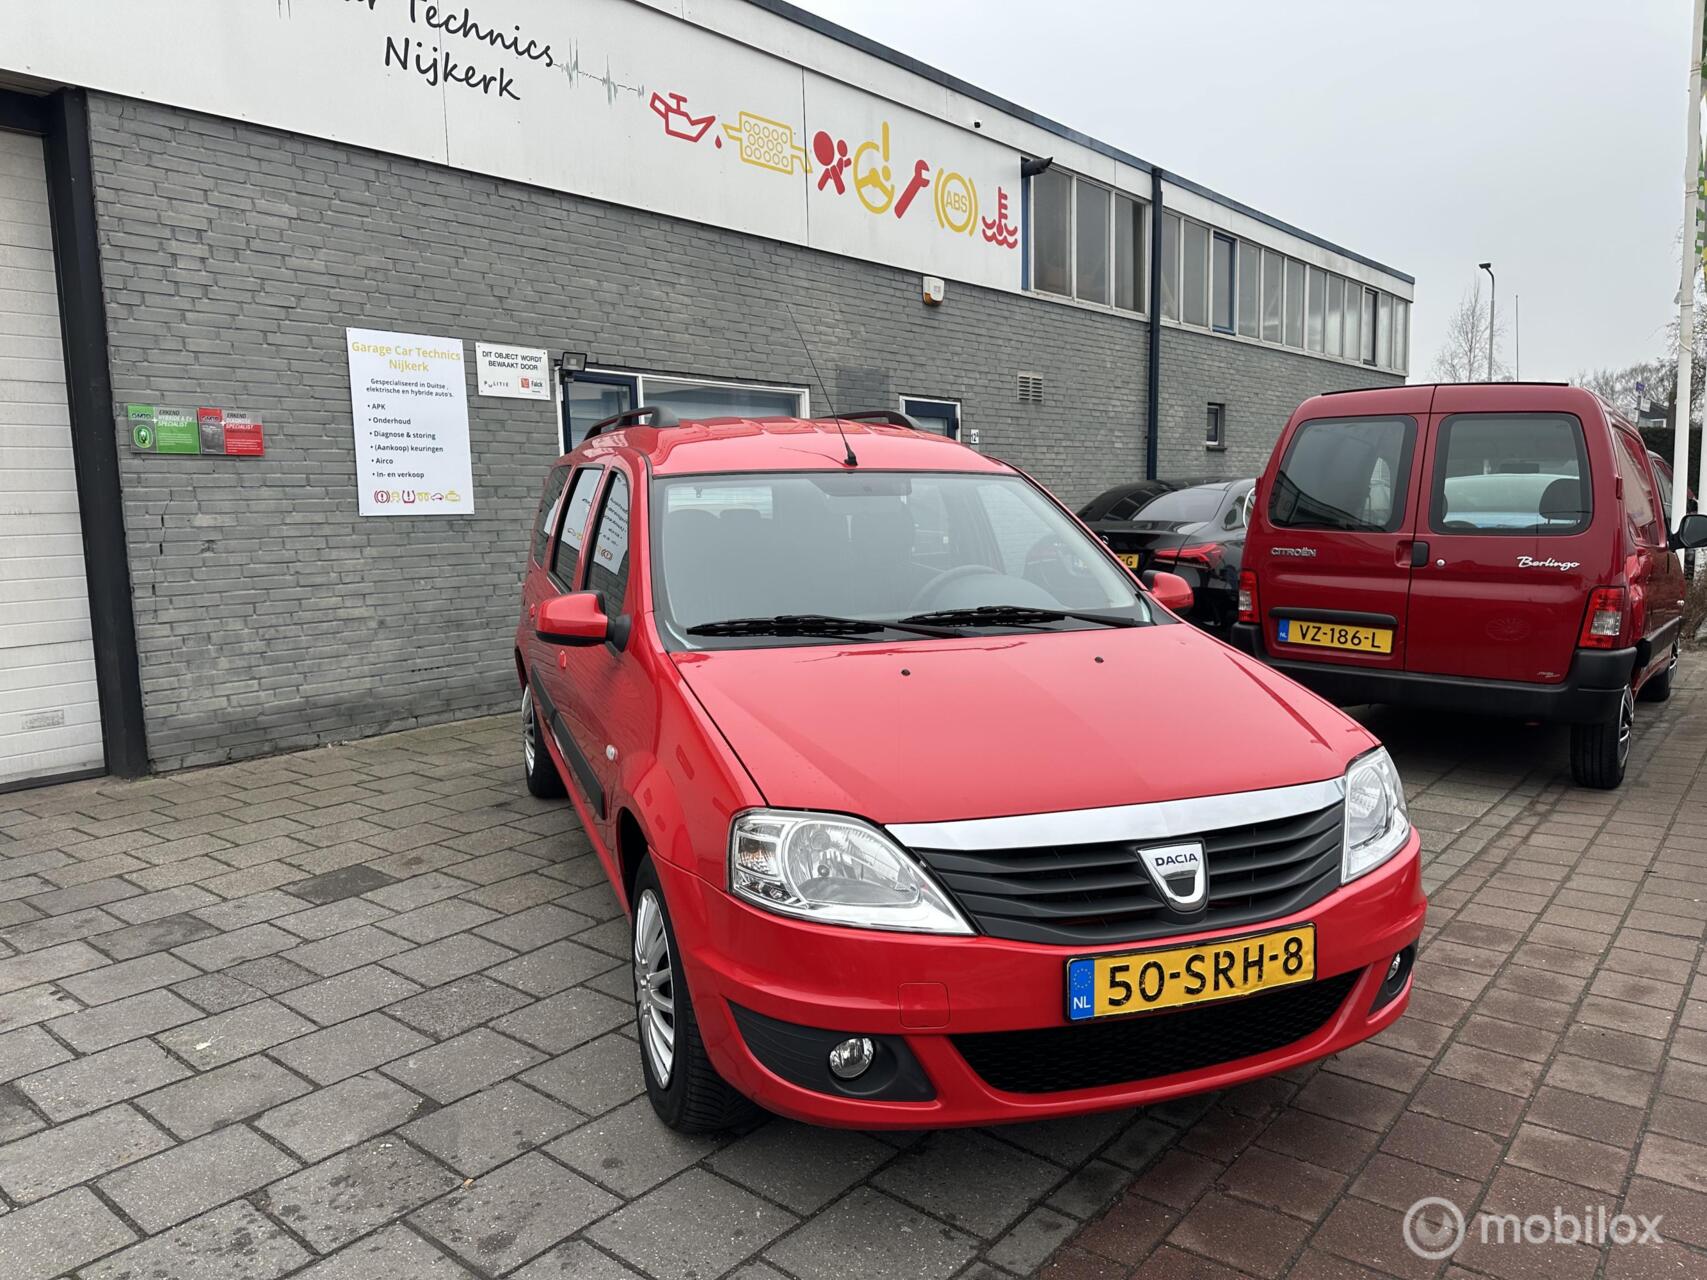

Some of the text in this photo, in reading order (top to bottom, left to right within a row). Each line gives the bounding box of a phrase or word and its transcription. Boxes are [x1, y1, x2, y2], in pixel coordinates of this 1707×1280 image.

[410, 0, 553, 67] Technics
[384, 36, 521, 101] Nijkerk
[946, 190, 967, 213] ABS
[351, 341, 461, 361] Garage Car Technics
[494, 352, 519, 361] OBJECT
[520, 354, 543, 363] WORDT
[389, 359, 430, 373] Nijkerk
[488, 360, 519, 369] BEWAAKT
[370, 378, 418, 388] Gespecialiseerd
[372, 416, 412, 425] Onderhoud
[374, 430, 404, 439] Diagnose
[412, 432, 436, 440] storing
[374, 444, 444, 454] (Aankoop) keuringen
[397, 472, 425, 480] verkoop
[1271, 547, 1316, 557] CITROËN
[1517, 556, 1580, 571] Berlingo
[1300, 624, 1381, 648] VZ-186-L
[1155, 853, 1198, 867] DACIA
[1108, 936, 1303, 1006] 50-SRH-8
[1073, 996, 1091, 1010] NL
